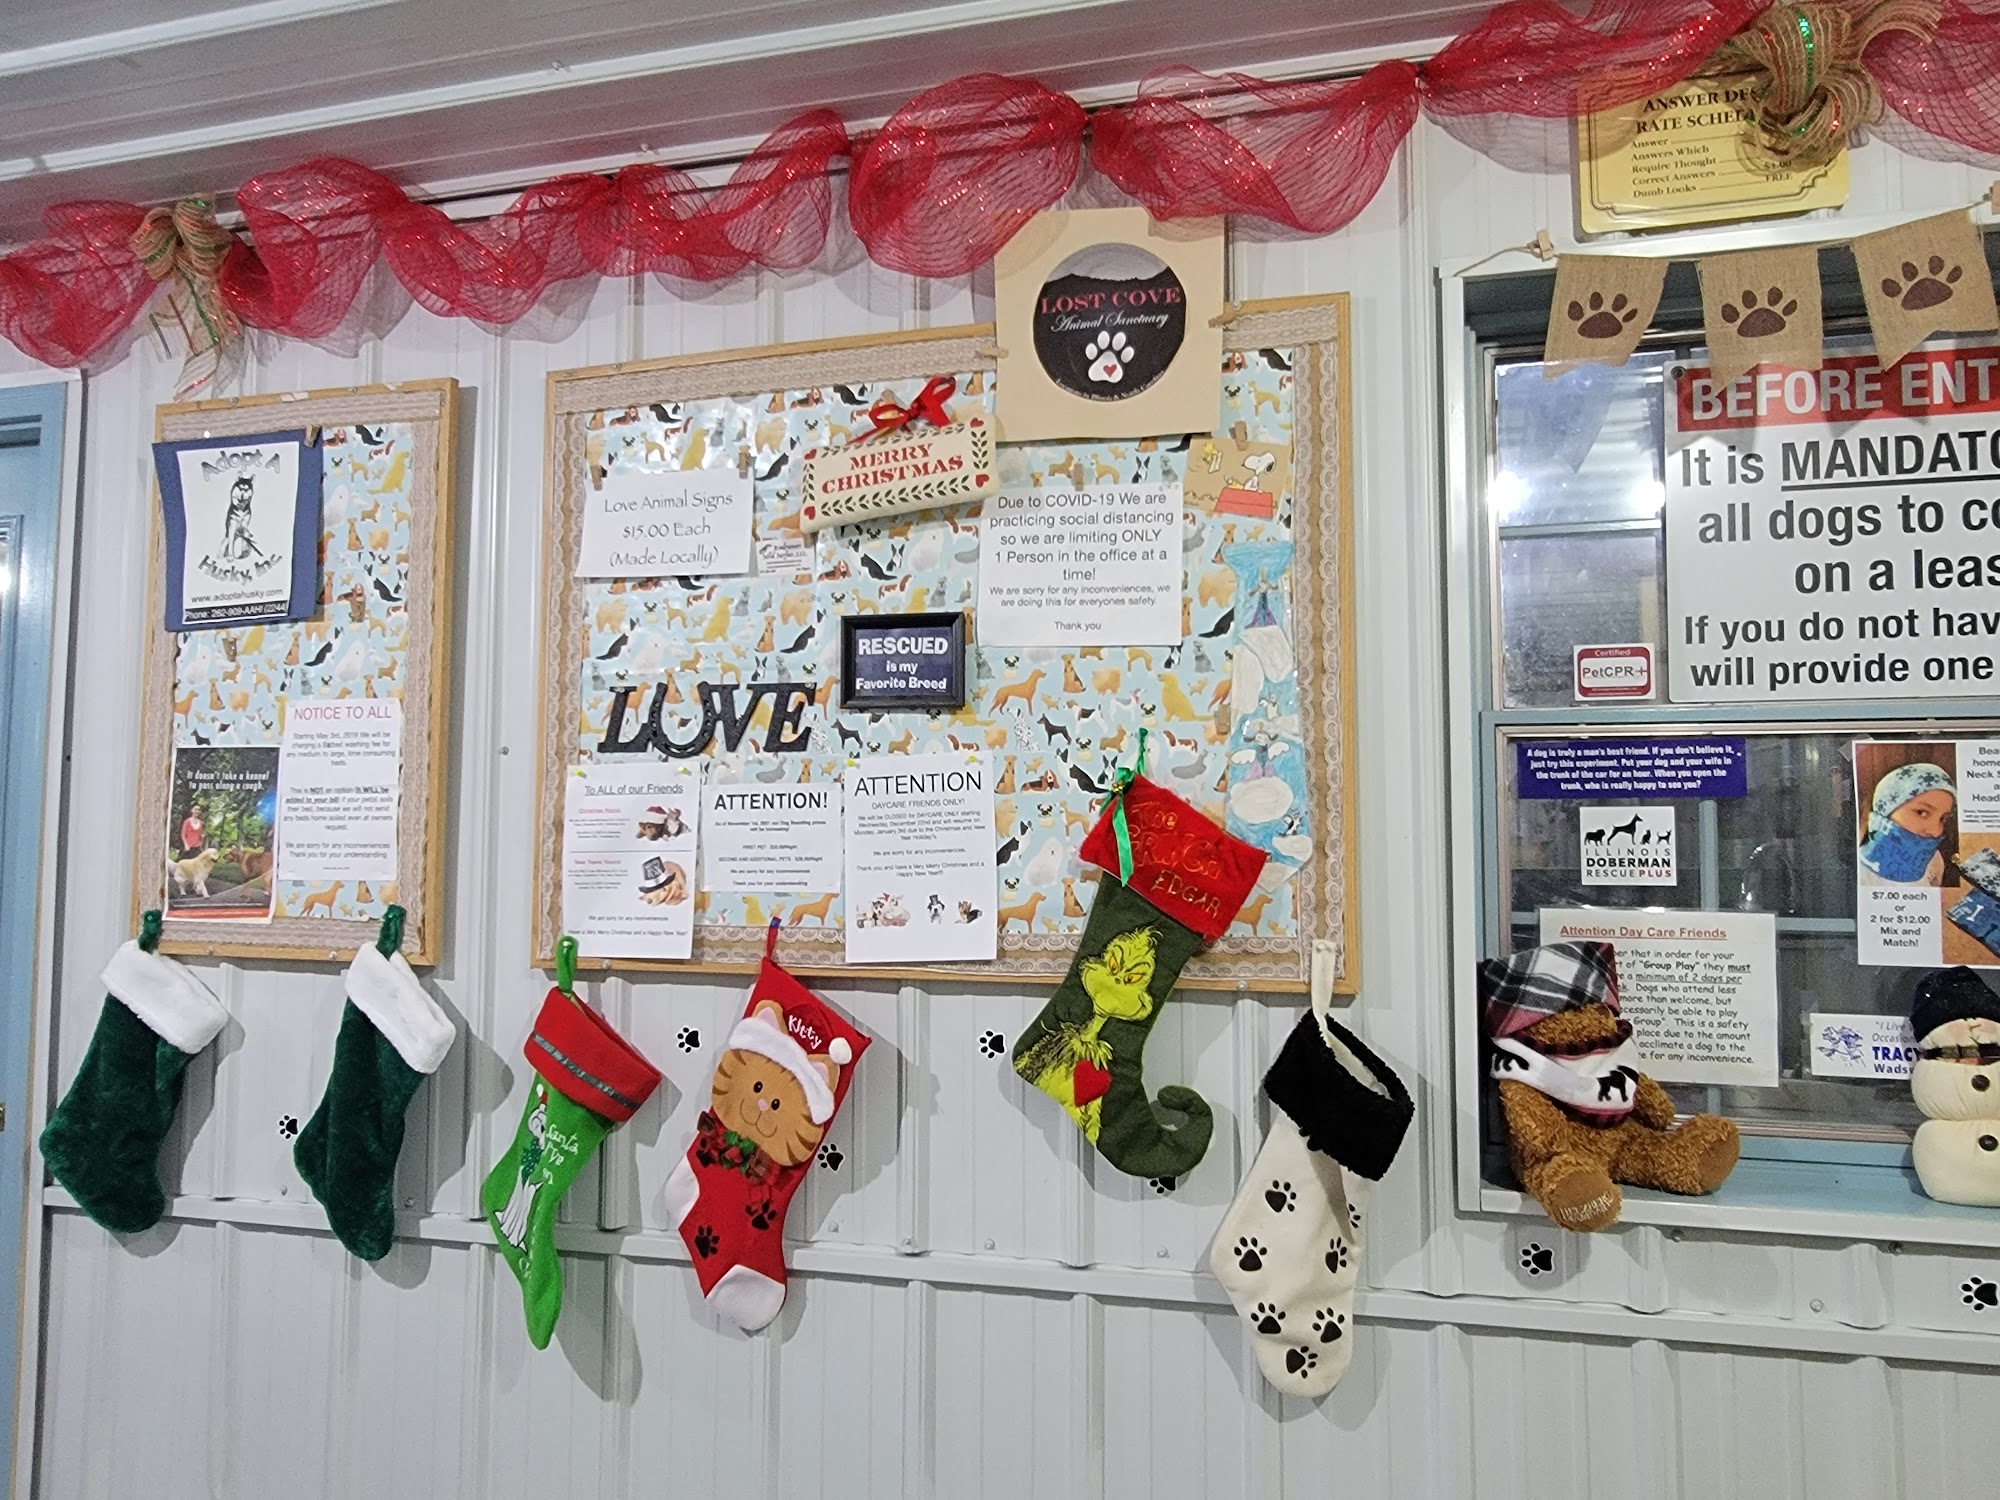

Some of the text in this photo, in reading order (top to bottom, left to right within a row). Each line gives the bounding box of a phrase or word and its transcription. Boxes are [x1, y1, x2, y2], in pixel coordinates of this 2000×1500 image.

[1643, 91, 1718, 112] ANSWER
[1636, 117, 1682, 133] RATE
[1631, 138, 1668, 149] Answer
[1631, 145, 1709, 161] Answers Which
[1632, 157, 1716, 173] Require Thought
[1632, 176, 1670, 186] Correct
[1672, 170, 1715, 180] Answers
[1633, 184, 1696, 198] Dumb Looks
[1041, 287, 1181, 314] LOST COVE
[1051, 310, 1168, 332] Animal Sanctuary
[1692, 358, 1998, 420] BEFORE ENT
[850, 443, 933, 470] MERRY
[201, 449, 280, 481] Adopt A
[1682, 449, 1711, 487] It
[1727, 446, 1764, 484] is
[822, 455, 963, 494] CHRISTMAS
[604, 489, 733, 512] Love Animal Signs
[998, 493, 1166, 508] Due to COVID-19 We are
[990, 511, 1174, 529] practicing social distancing
[1699, 503, 1750, 543] all
[1769, 500, 1882, 546] dogs
[1898, 496, 1943, 533] to
[622, 518, 711, 540] $15.00 Each
[1000, 529, 1162, 546] so we are limiting ONLY
[610, 545, 718, 569] (Made Locally)
[995, 549, 1167, 563] 1 Person in the office at a
[1063, 568, 1096, 580] time!
[1795, 561, 1850, 594] on
[1869, 559, 1894, 591] a
[1055, 621, 1102, 632] Thank you
[1685, 616, 1708, 644] If
[1720, 619, 1785, 649] you
[1800, 611, 1844, 641] do
[1859, 609, 1919, 639] not
[859, 637, 948, 656] RESCUED
[886, 660, 918, 674] is my
[1691, 653, 1993, 691] will provide one
[856, 677, 946, 691] Favorite Breed
[294, 706, 392, 720] NOTICE TO ALL
[598, 682, 817, 758] LOVE
[1534, 749, 1548, 758] dog
[1556, 749, 1575, 758] truly
[1584, 748, 1605, 756] man's
[1659, 748, 1673, 756] you
[1675, 746, 1694, 754] don't
[1695, 746, 1723, 754] believe
[187, 771, 193, 779] It
[195, 770, 220, 780] doesn't
[222, 772, 237, 781] take
[246, 770, 270, 780] kennel
[1967, 770, 1994, 778] Neck
[198, 782, 213, 791] pass
[216, 781, 234, 791] along
[242, 782, 264, 791] cough.
[585, 784, 683, 795] To ALL of our Friends
[854, 771, 982, 796] ATTENTION
[714, 792, 828, 810] ATTENTION!
[872, 798, 965, 809] DAYCARE FRIENDS ONLY!
[1585, 848, 1670, 856] ILLINOIS
[1587, 858, 1670, 867] DOBERMAN
[1872, 891, 1927, 900] $7.00 each
[1880, 915, 1894, 923] for
[1897, 915, 1930, 924] $12.00
[1560, 926, 1727, 939] Attention Day Care Friends
[1883, 939, 1918, 947] Match!
[1631, 950, 1650, 958] that
[1665, 950, 1691, 958] order
[1695, 950, 1710, 958] for
[1713, 953, 1734, 962] your
[1704, 963, 1725, 972] they
[1728, 964, 1751, 972] must
[1872, 1046, 1921, 1061] TRACY
